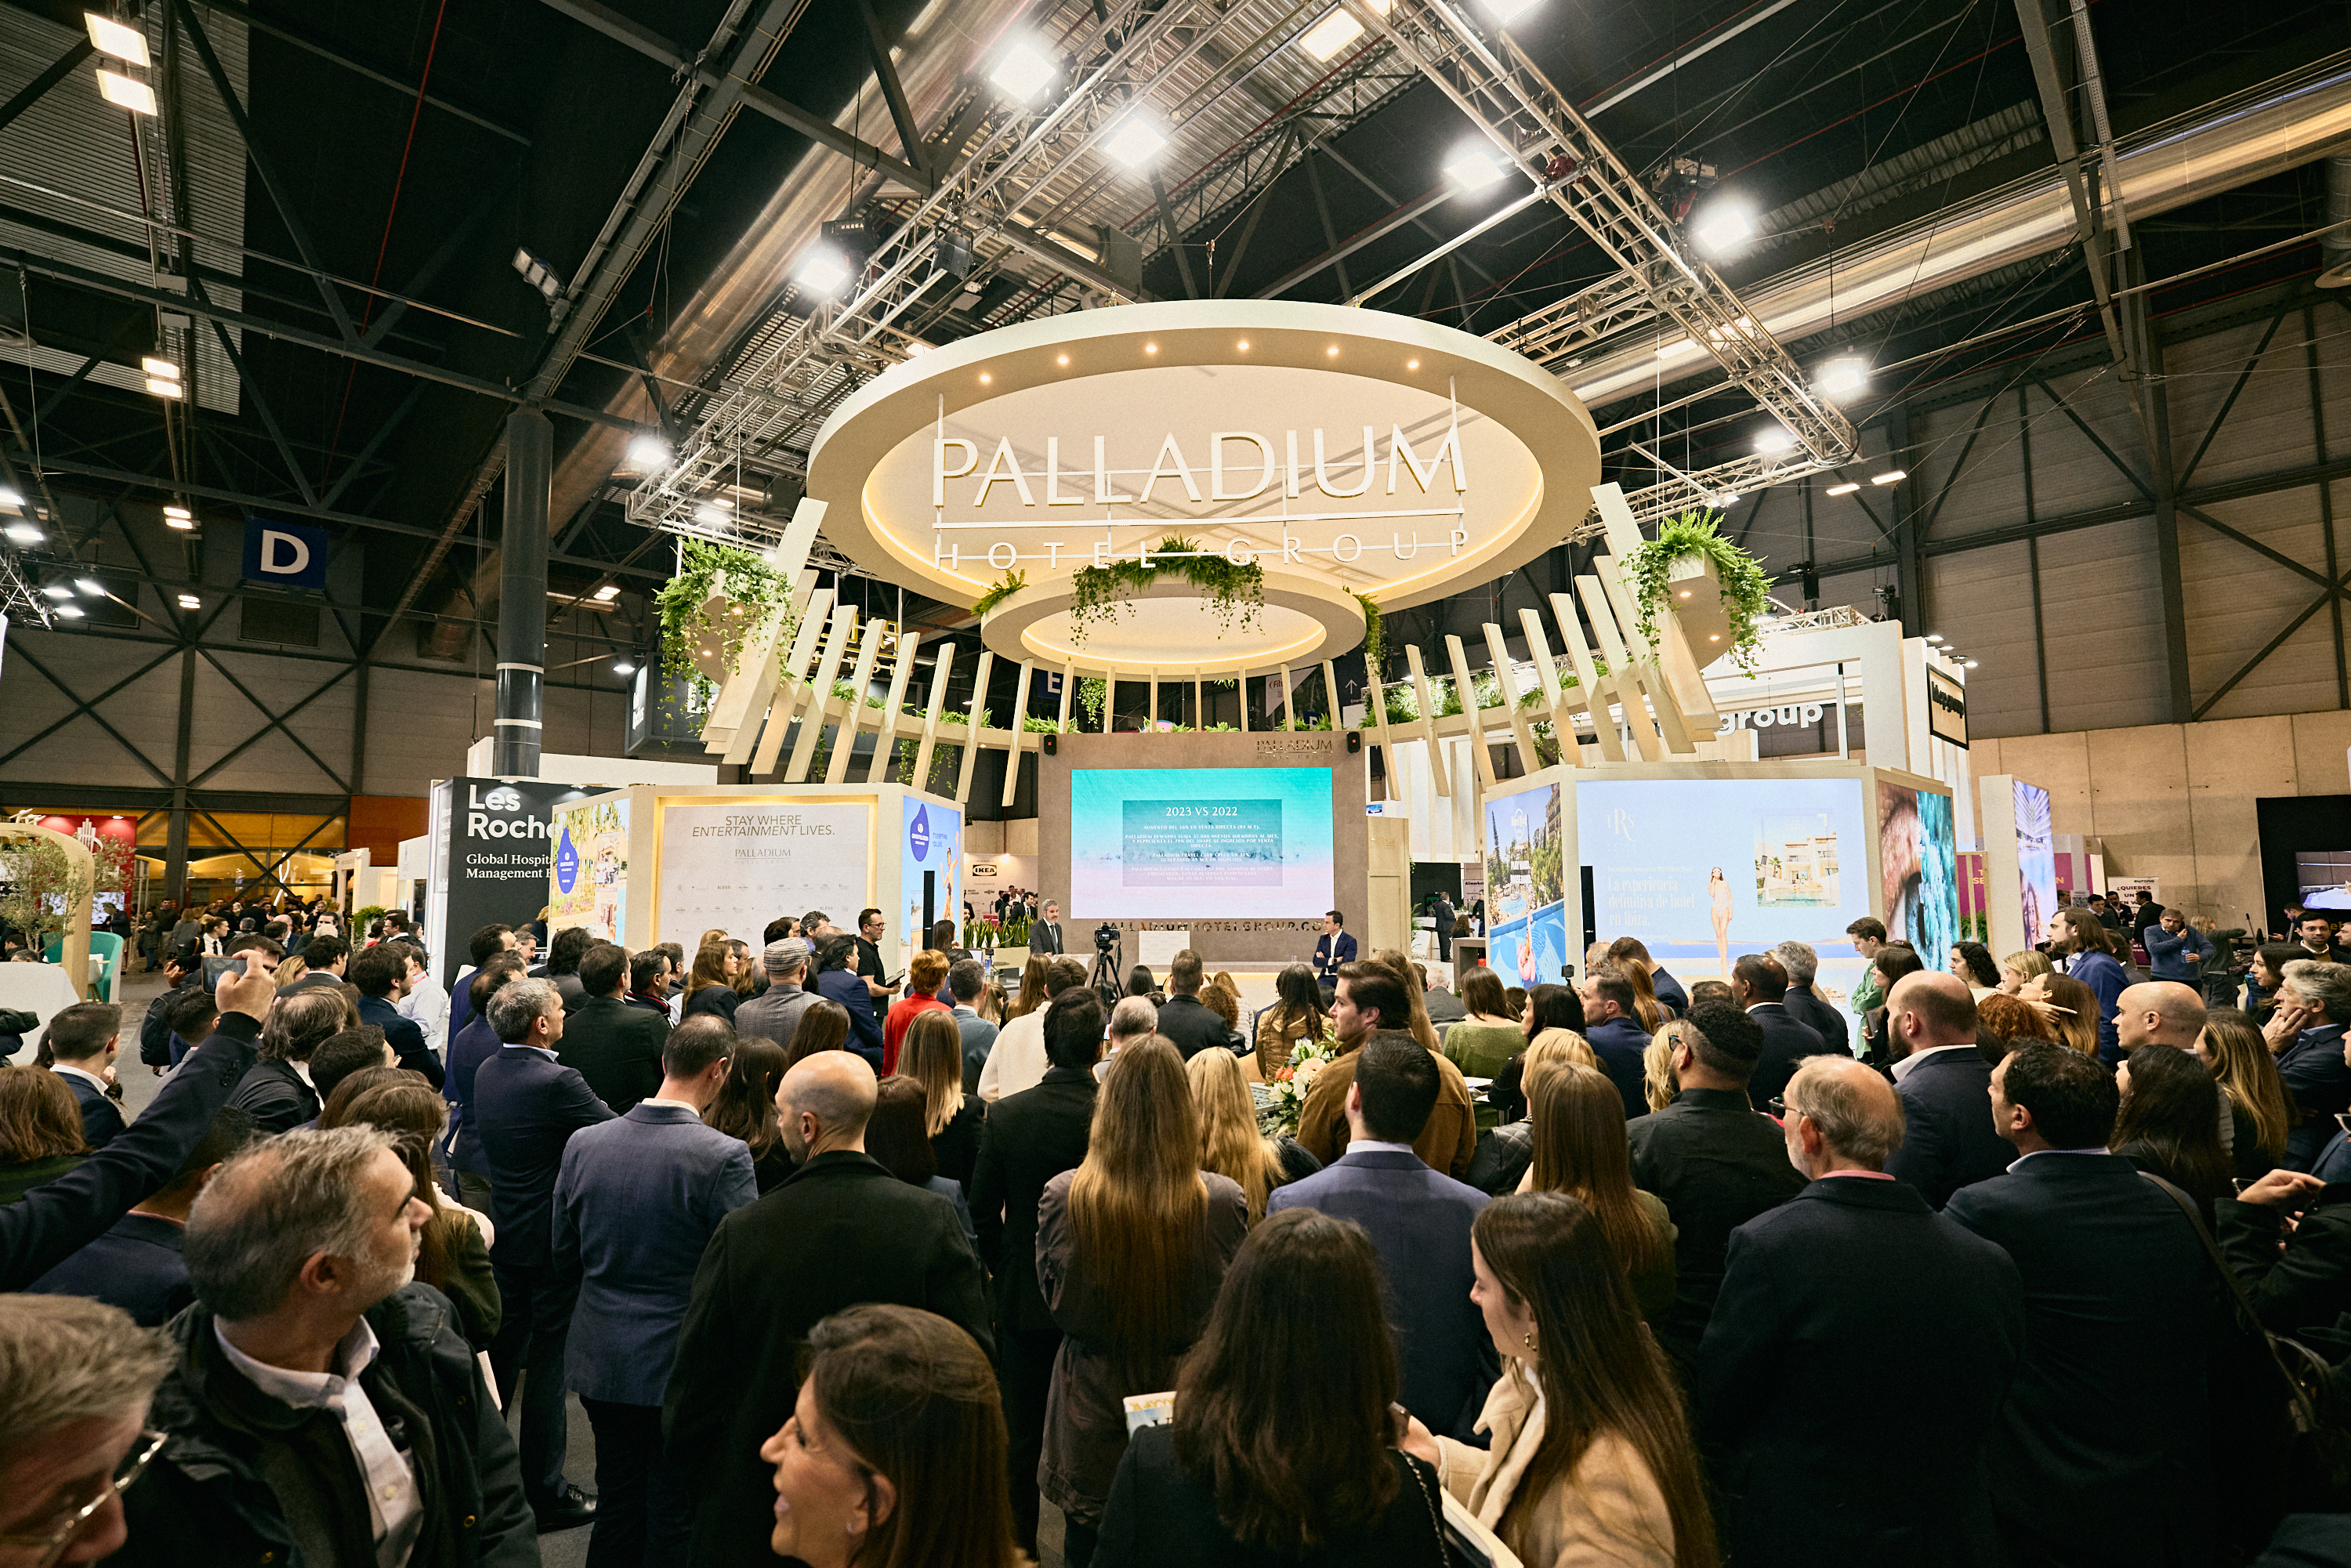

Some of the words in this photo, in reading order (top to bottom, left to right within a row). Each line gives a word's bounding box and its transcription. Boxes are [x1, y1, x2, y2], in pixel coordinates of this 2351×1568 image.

[933, 422, 1467, 507] PALLADIUM
[260, 529, 310, 574] D
[935, 539, 1157, 570] HOTEL
[1226, 529, 1470, 567] GROUP
[1047, 671, 1061, 694] E
[1717, 704, 1824, 736] group
[469, 784, 521, 812] Les
[1165, 806, 1192, 817] 2023
[1195, 806, 1209, 817] VS
[1212, 806, 1238, 817] 2022
[726, 816, 755, 826] STAY
[757, 815, 802, 825] WHERE
[692, 826, 798, 837] ENTERTAINMENT
[800, 825, 835, 835] LIVES.
[465, 853, 508, 864] Global
[511, 853, 552, 867] Hospit
[735, 849, 792, 857] PALLADIUM
[465, 868, 543, 881] Management
[1608, 877, 1619, 891] La
[1621, 876, 1678, 896] experiencia
[1608, 893, 1654, 908] definitiva
[1656, 893, 1668, 908] de
[1671, 893, 1694, 908] hotel
[1609, 914, 1621, 925] en
[1625, 911, 1650, 925] Ibiza.
[1101, 922, 1322, 931] ALLADIUMHOTELGROUP.CO
